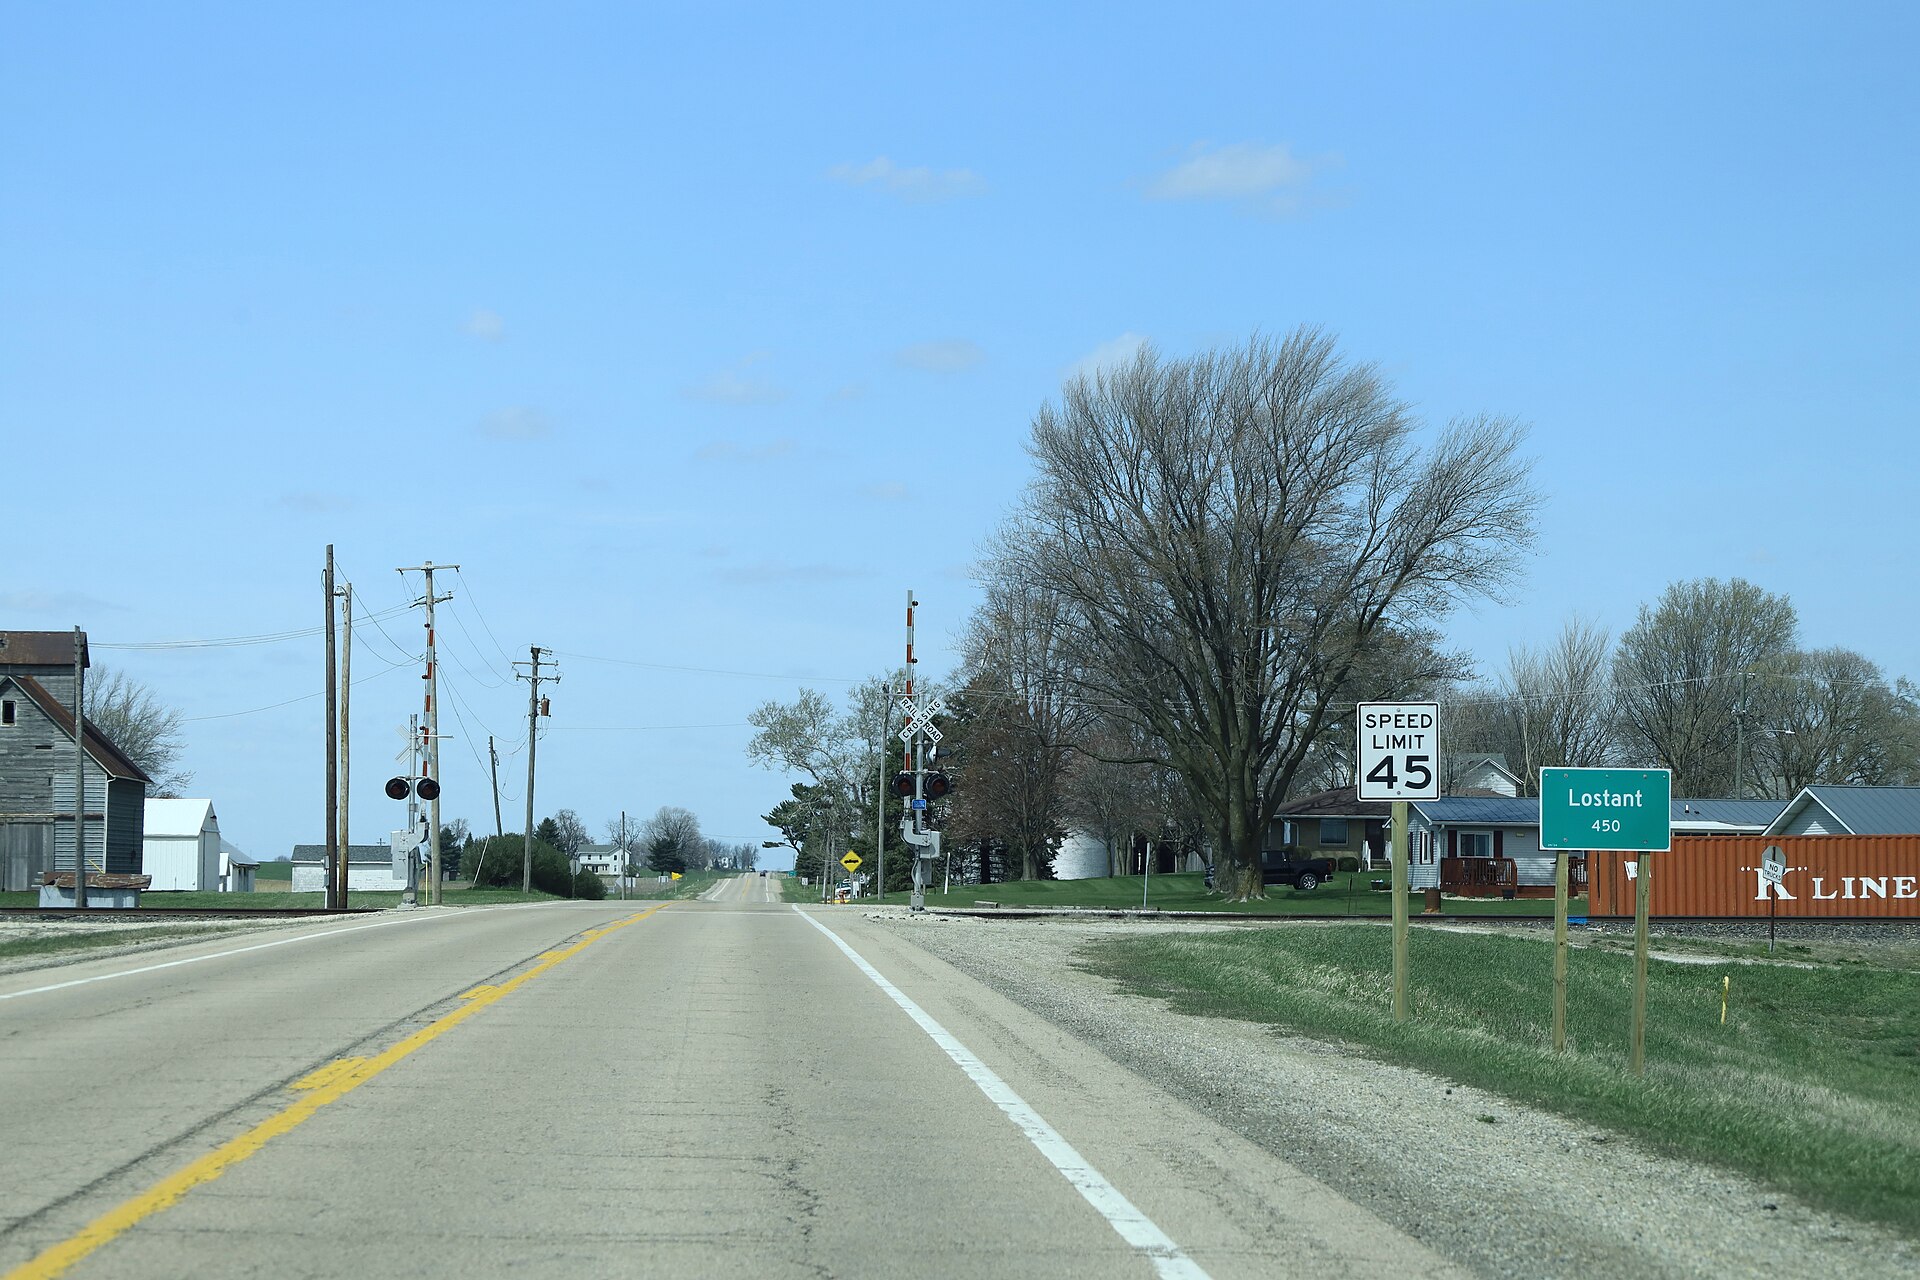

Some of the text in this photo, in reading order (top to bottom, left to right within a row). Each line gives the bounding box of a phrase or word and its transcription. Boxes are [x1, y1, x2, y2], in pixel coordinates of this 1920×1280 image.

[901, 699, 941, 741] RAIL ROAD
[902, 701, 940, 739] CROSSING
[1365, 713, 1433, 729] SPEED
[1372, 734, 1425, 750] LIMIT
[1366, 755, 1432, 790] 45
[1568, 788, 1643, 808] Lostant
[1591, 819, 1621, 833] 450
[1764, 869, 1782, 881] TRUCKS
[1768, 863, 1779, 873] NO
[1811, 876, 1919, 899] LINE
